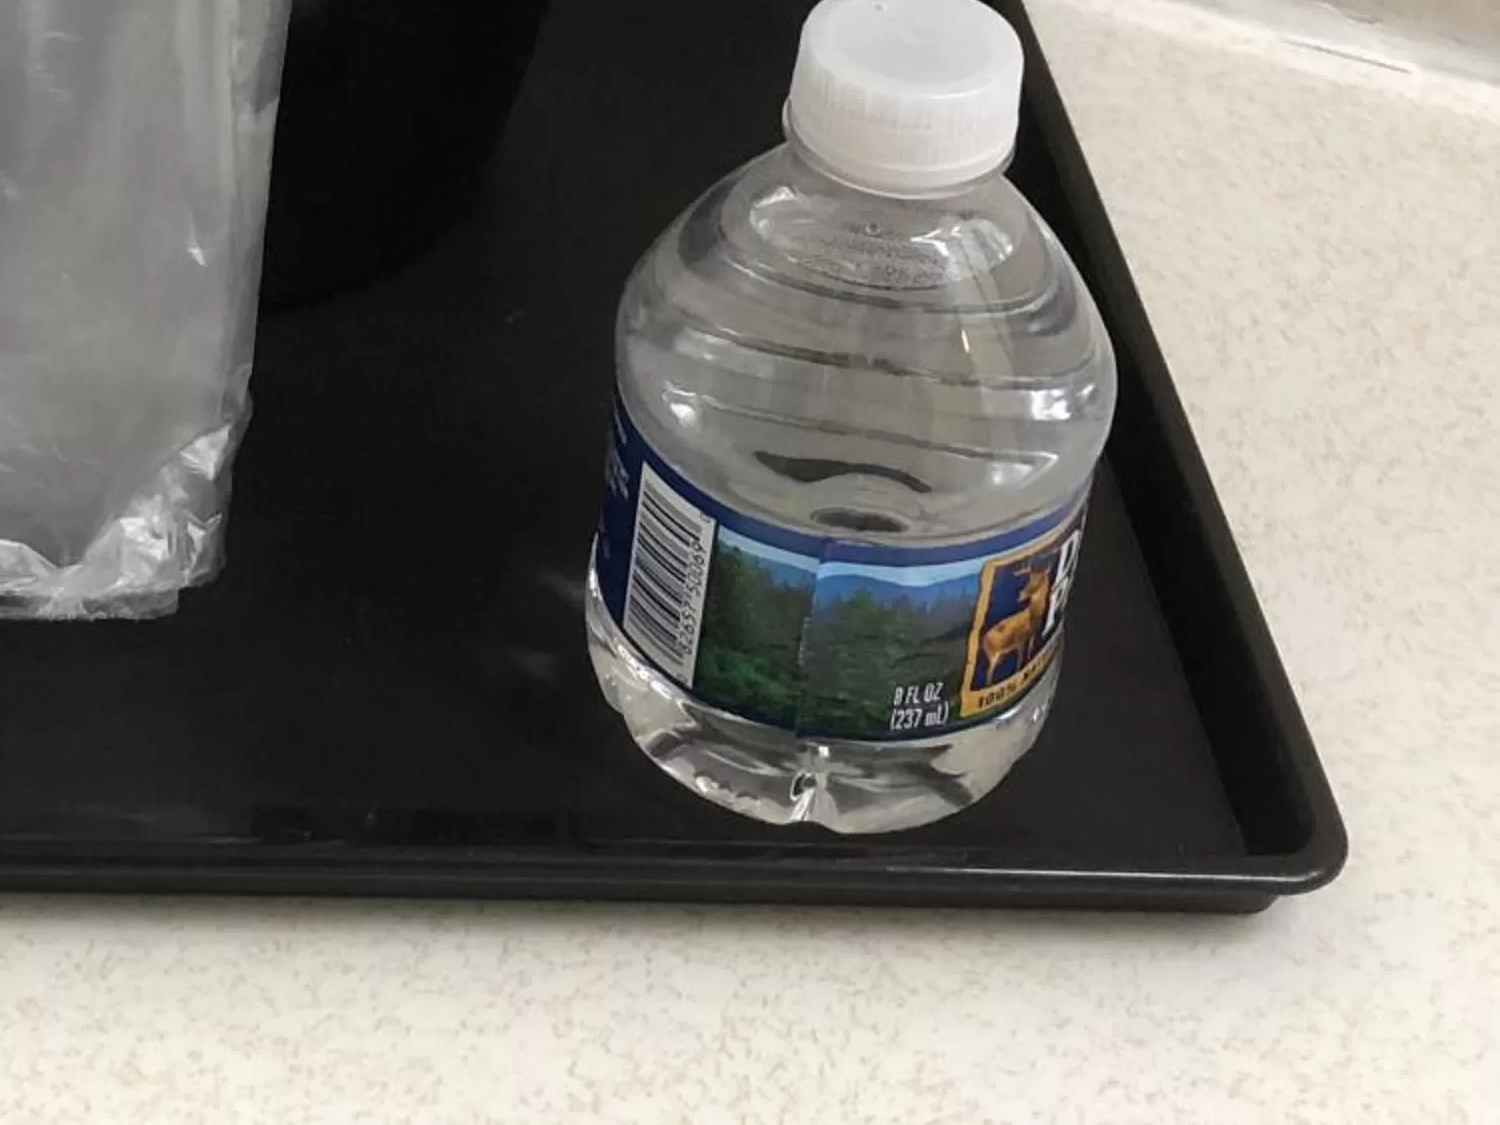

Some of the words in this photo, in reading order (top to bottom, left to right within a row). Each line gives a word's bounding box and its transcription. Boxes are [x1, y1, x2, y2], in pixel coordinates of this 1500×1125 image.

[893, 686, 903, 706] 8
[905, 686, 919, 704] FL
[923, 682, 943, 703] OZ
[890, 708, 922, 731] (237
